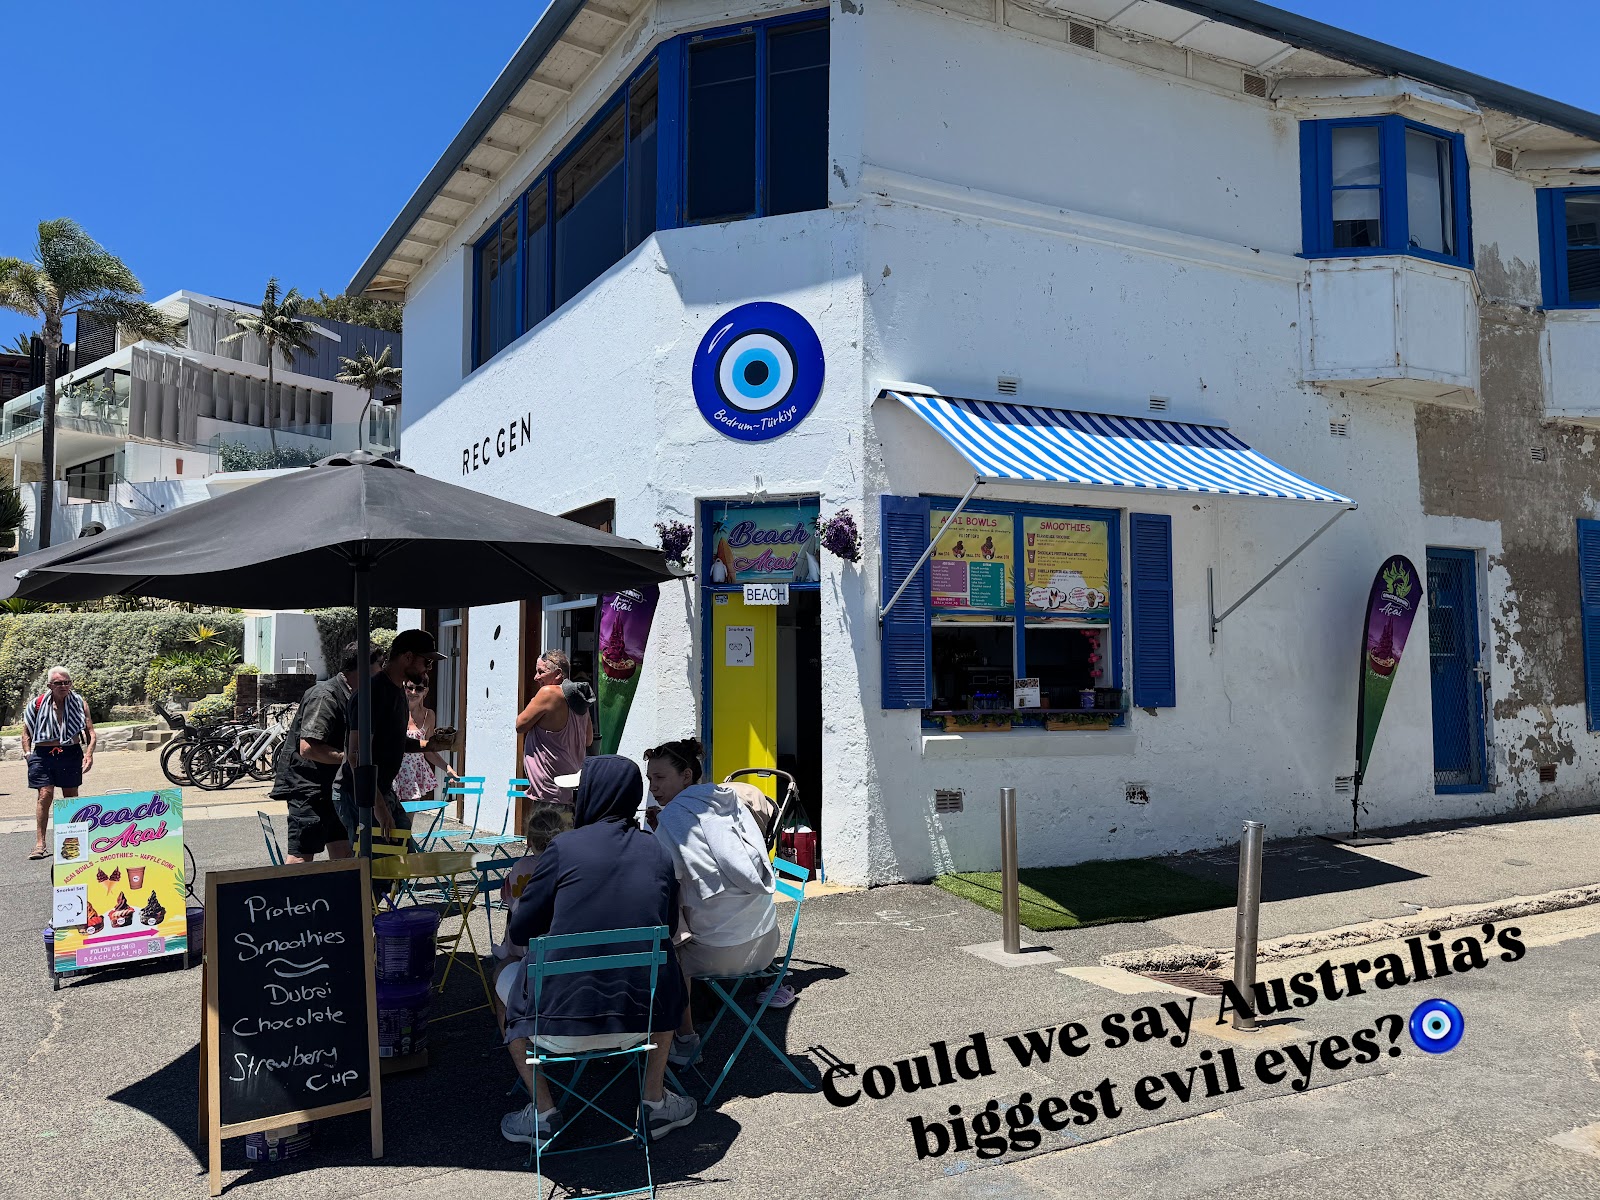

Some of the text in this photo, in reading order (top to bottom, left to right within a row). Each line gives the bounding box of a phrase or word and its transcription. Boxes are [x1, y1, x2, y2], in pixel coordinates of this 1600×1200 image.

[462, 411, 531, 476] REC GEN
[727, 520, 811, 548] Beach
[966, 517, 997, 527] BOWLS
[1040, 521, 1091, 532] SMOOTHIES
[733, 547, 799, 573] Açai
[609, 595, 633, 612] Açai
[747, 588, 786, 601] BEACH
[69, 793, 170, 833] Beach
[91, 820, 169, 853] Açai
[63, 872, 77, 884] ACAI
[75, 861, 94, 875] BOWLS
[99, 852, 134, 863] SMOOTHIES
[140, 853, 161, 864] WAFFLE
[160, 860, 176, 871] CONE
[244, 895, 330, 923] Protein
[89, 946, 111, 955] FOLLOW
[234, 930, 346, 962] Smoothies
[263, 982, 332, 1005] Dubai
[232, 1006, 347, 1036] Chocolate
[229, 1045, 338, 1081] Strawberry
